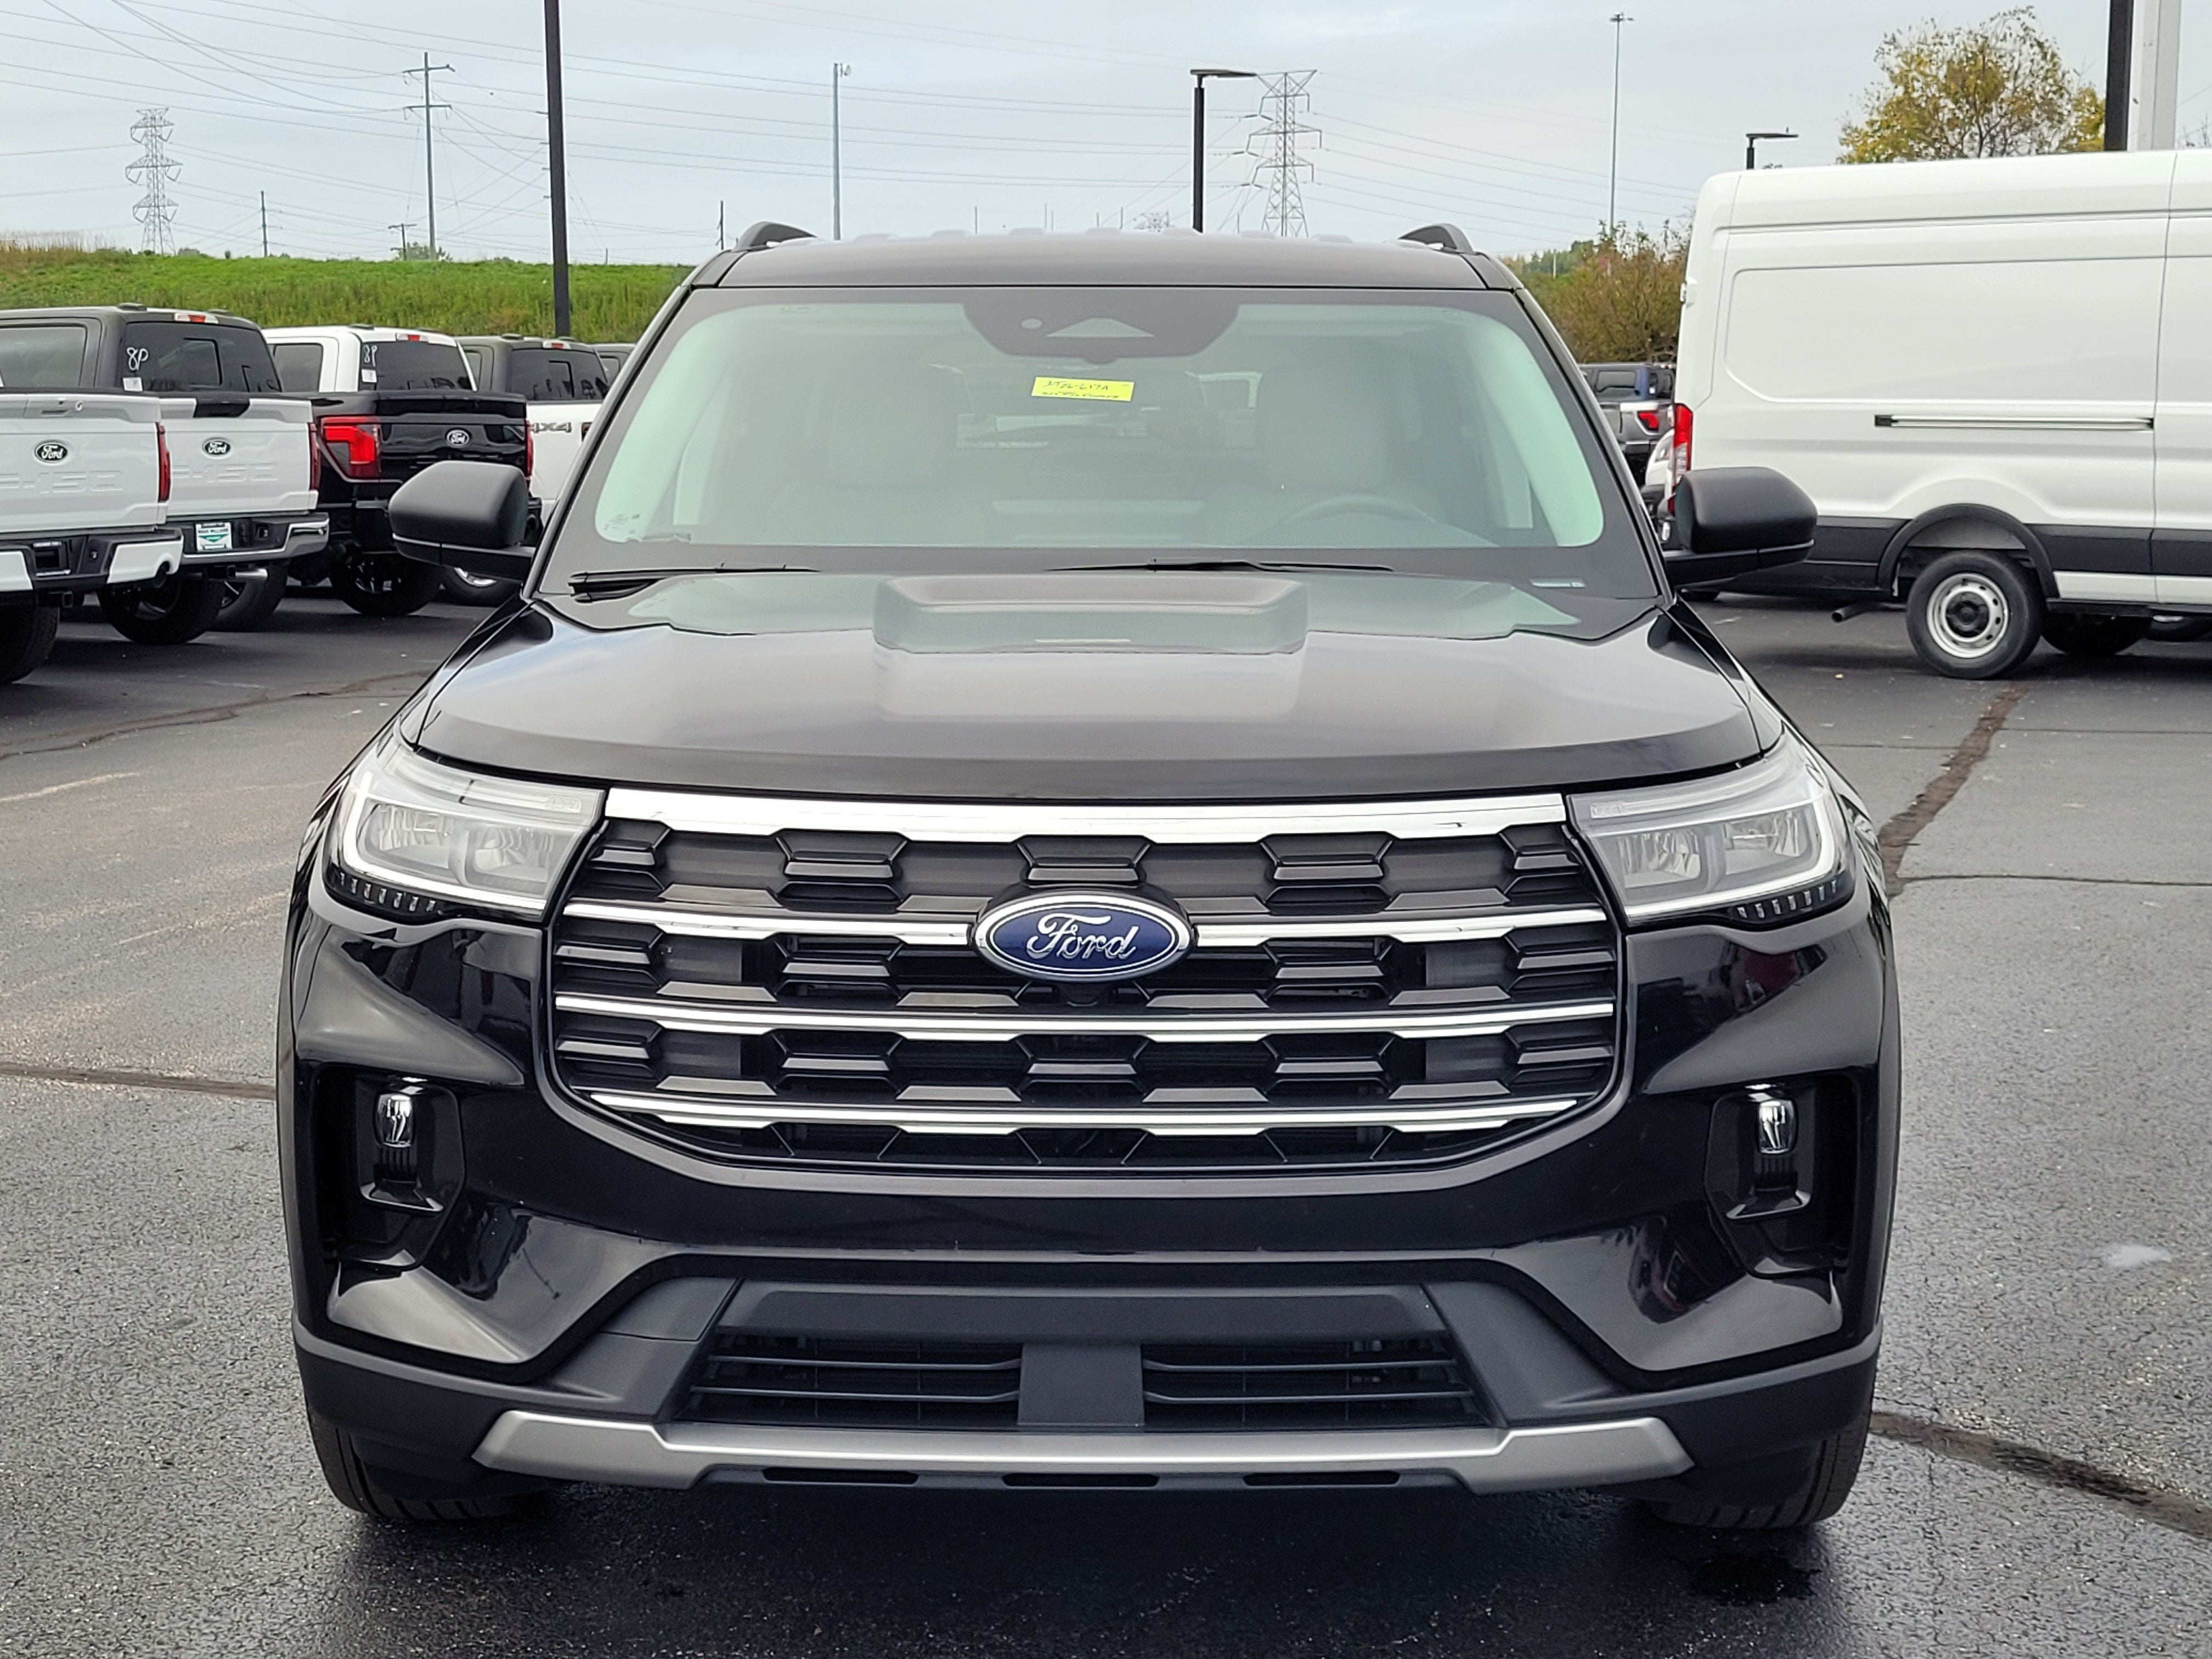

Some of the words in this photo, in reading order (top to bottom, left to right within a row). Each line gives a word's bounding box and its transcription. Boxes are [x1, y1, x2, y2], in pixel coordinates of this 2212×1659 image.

[42, 445, 63, 459] Ford
[208, 442, 227, 453] Ford
[1026, 913, 1139, 959] Ford
